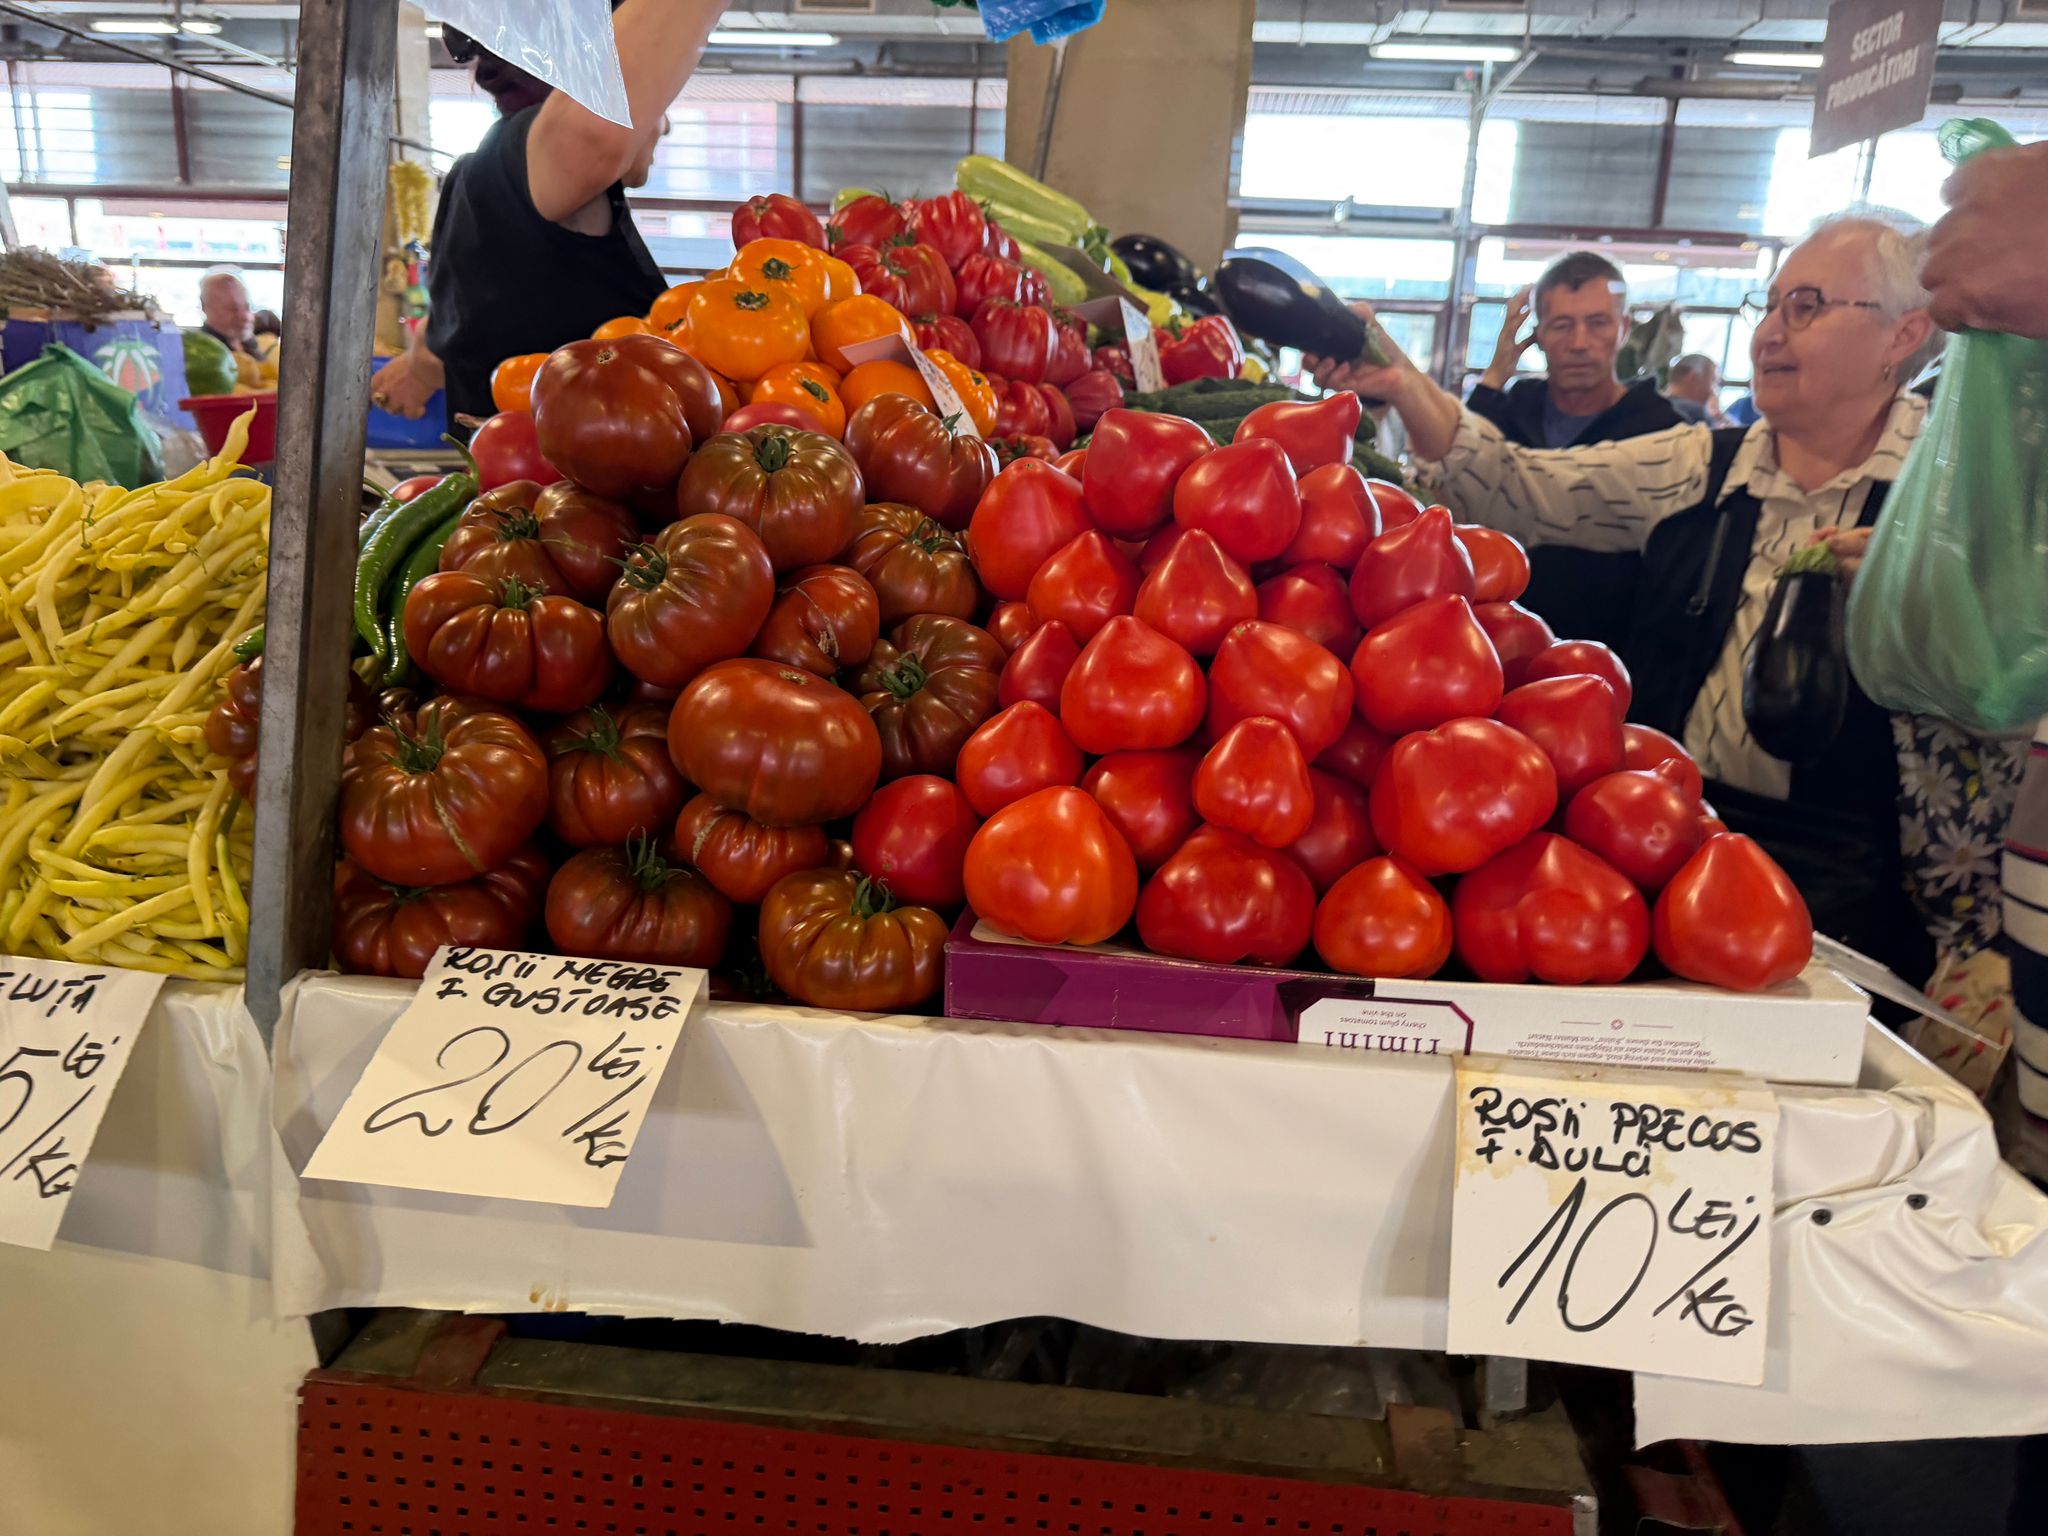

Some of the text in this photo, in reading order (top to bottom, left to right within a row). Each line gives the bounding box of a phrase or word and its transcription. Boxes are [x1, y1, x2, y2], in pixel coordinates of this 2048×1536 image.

[1850, 10, 1904, 62] SECTOR
[483, 982, 681, 1021] GUSTOASE
[1339, 1017, 1377, 1026] tomatoes
[364, 1026, 582, 1136] 20
[1610, 1102, 1761, 1153] PRECOS
[1498, 1176, 1658, 1332] 10
